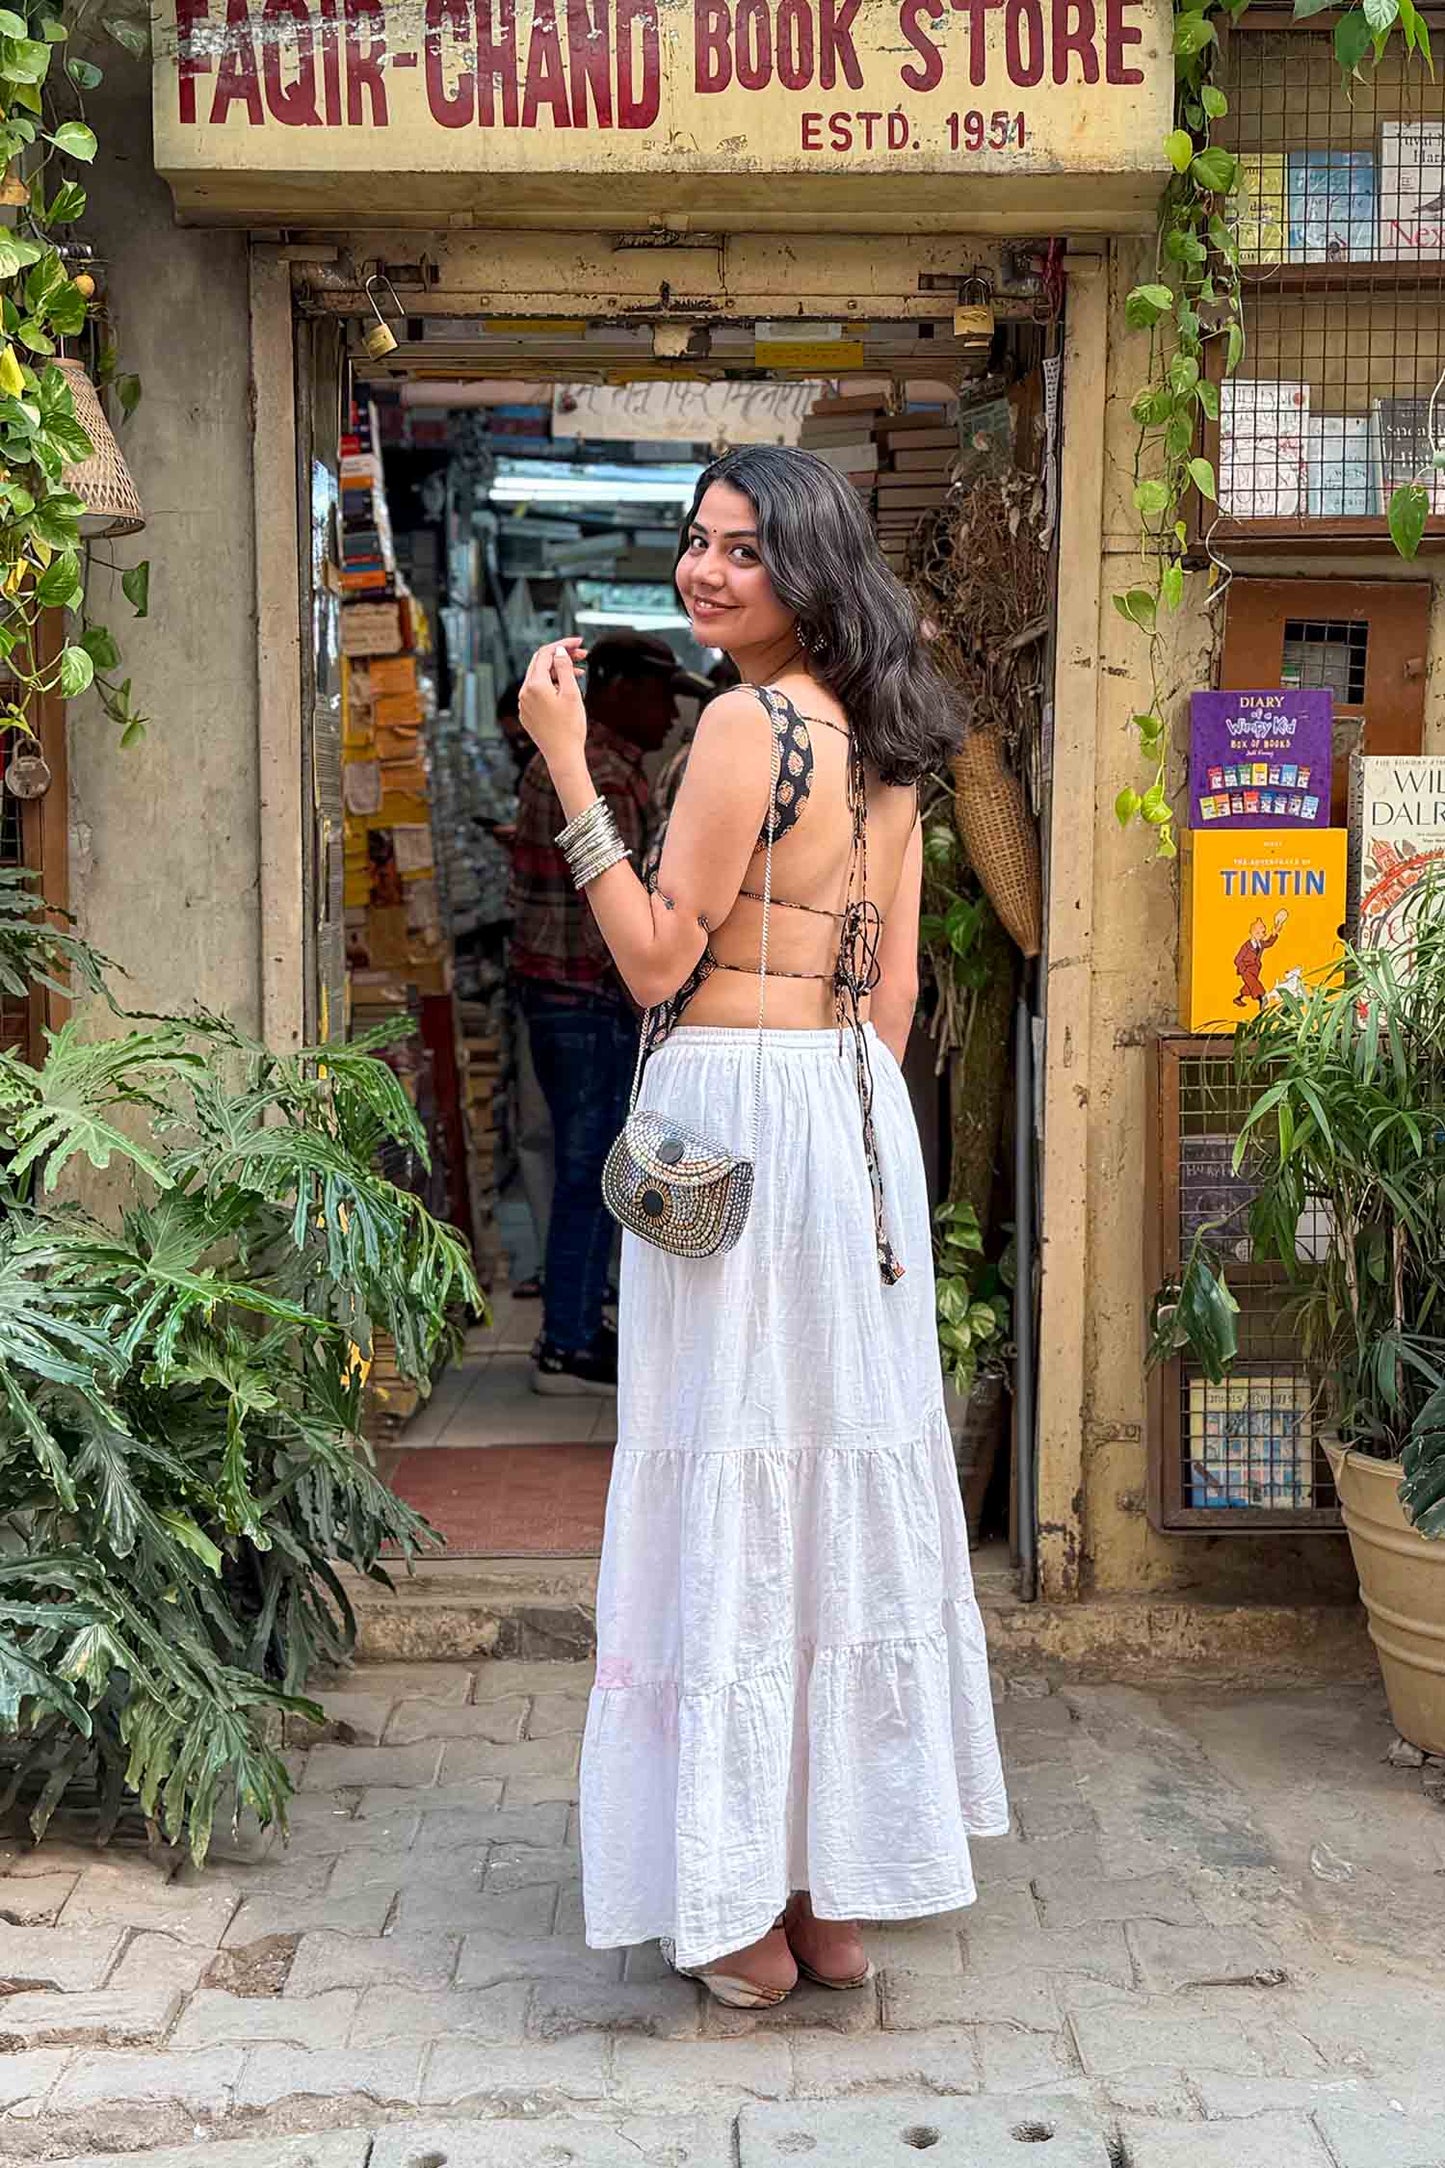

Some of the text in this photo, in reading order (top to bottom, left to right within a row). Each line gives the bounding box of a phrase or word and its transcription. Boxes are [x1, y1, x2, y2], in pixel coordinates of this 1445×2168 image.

[176, 0, 1145, 129] FAQIR-CHAND BOOK STORE
[801, 110, 1026, 152] ESTD. 1951
[1240, 696, 1285, 708] DIARY
[1250, 707, 1263, 719] of
[1225, 716, 1297, 739] Wimpy Kid
[1230, 739, 1248, 749] BOX
[1263, 739, 1292, 749] BOOKS
[1393, 770, 1445, 793] WIL
[1372, 801, 1445, 826] DALR
[1219, 870, 1325, 896] TINTIN
